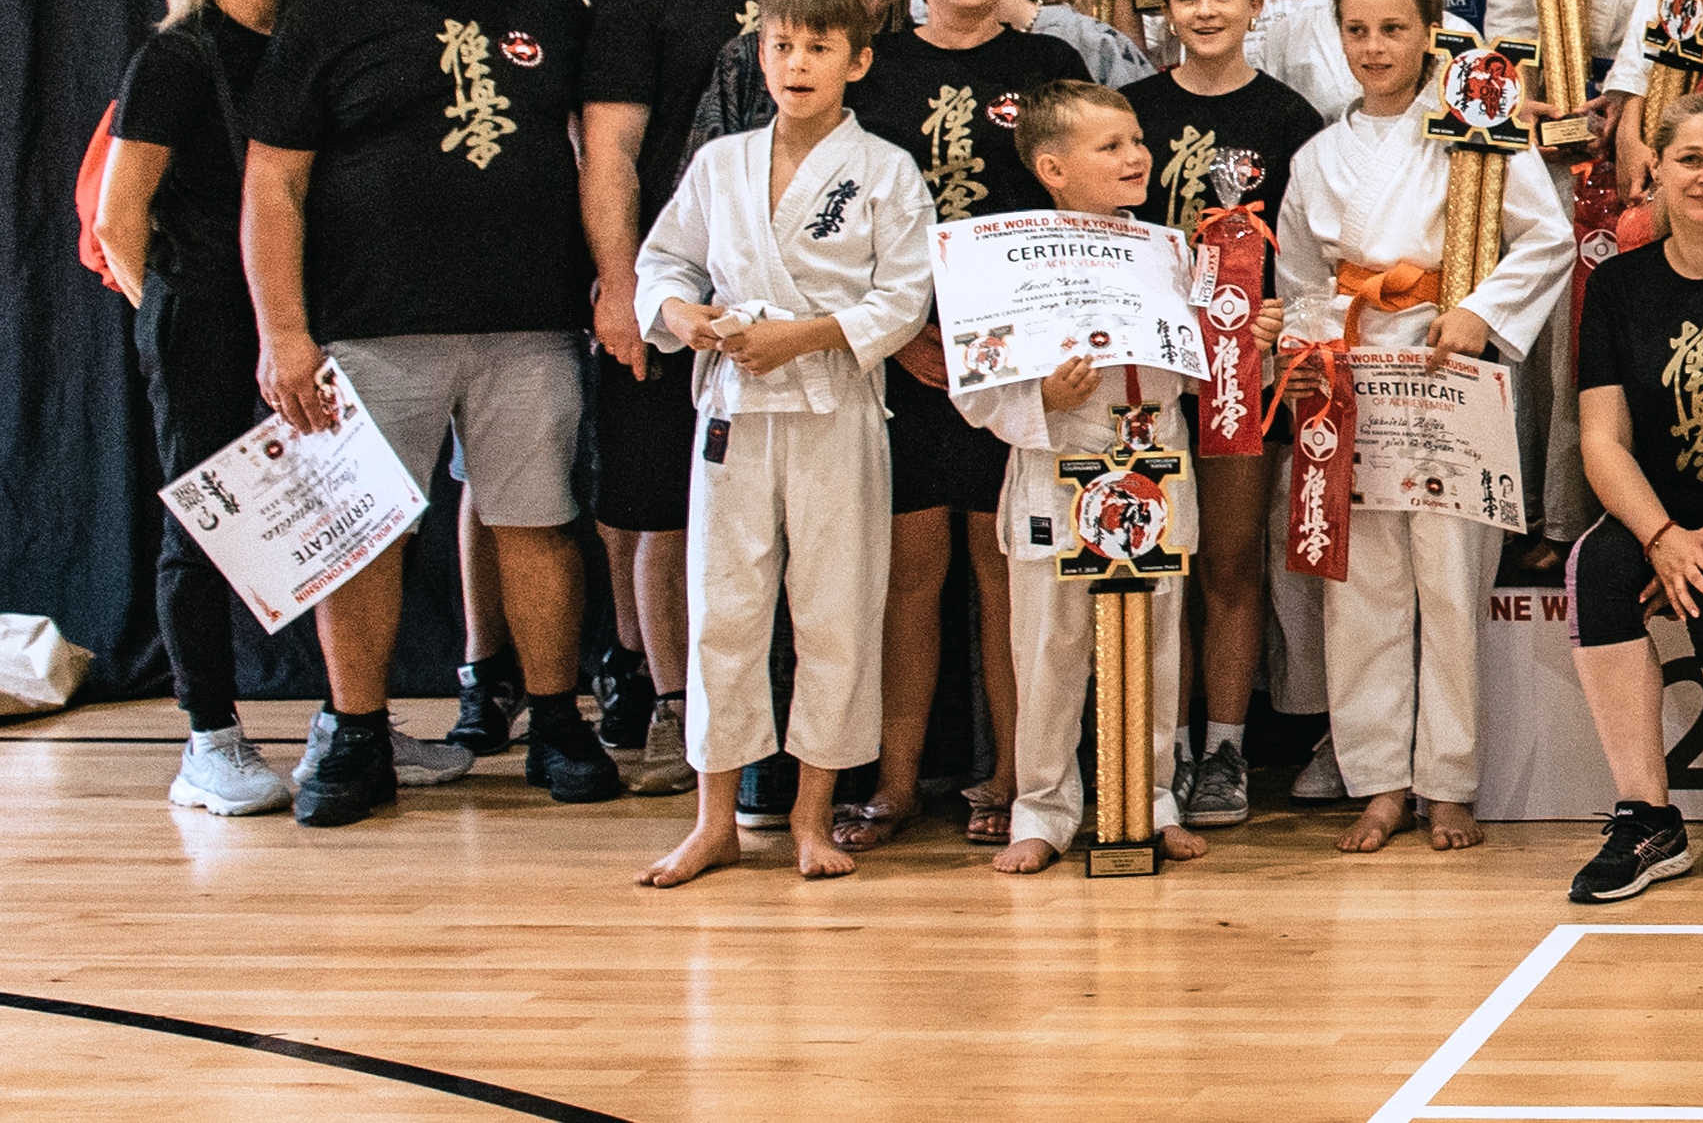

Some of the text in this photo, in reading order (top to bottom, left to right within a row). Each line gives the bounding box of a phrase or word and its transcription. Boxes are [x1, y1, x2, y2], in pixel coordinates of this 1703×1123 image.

[973, 217, 1150, 236] ONE WORLD ONE KYOKUSHIN
[1007, 243, 1134, 263] CERTIFICATE
[1351, 354, 1394, 364] WORLD
[1397, 354, 1421, 363] ONE
[1355, 381, 1466, 406] CERTIFICATE
[291, 493, 375, 566] CERTIFICATE
[1486, 596, 1531, 621] NE
